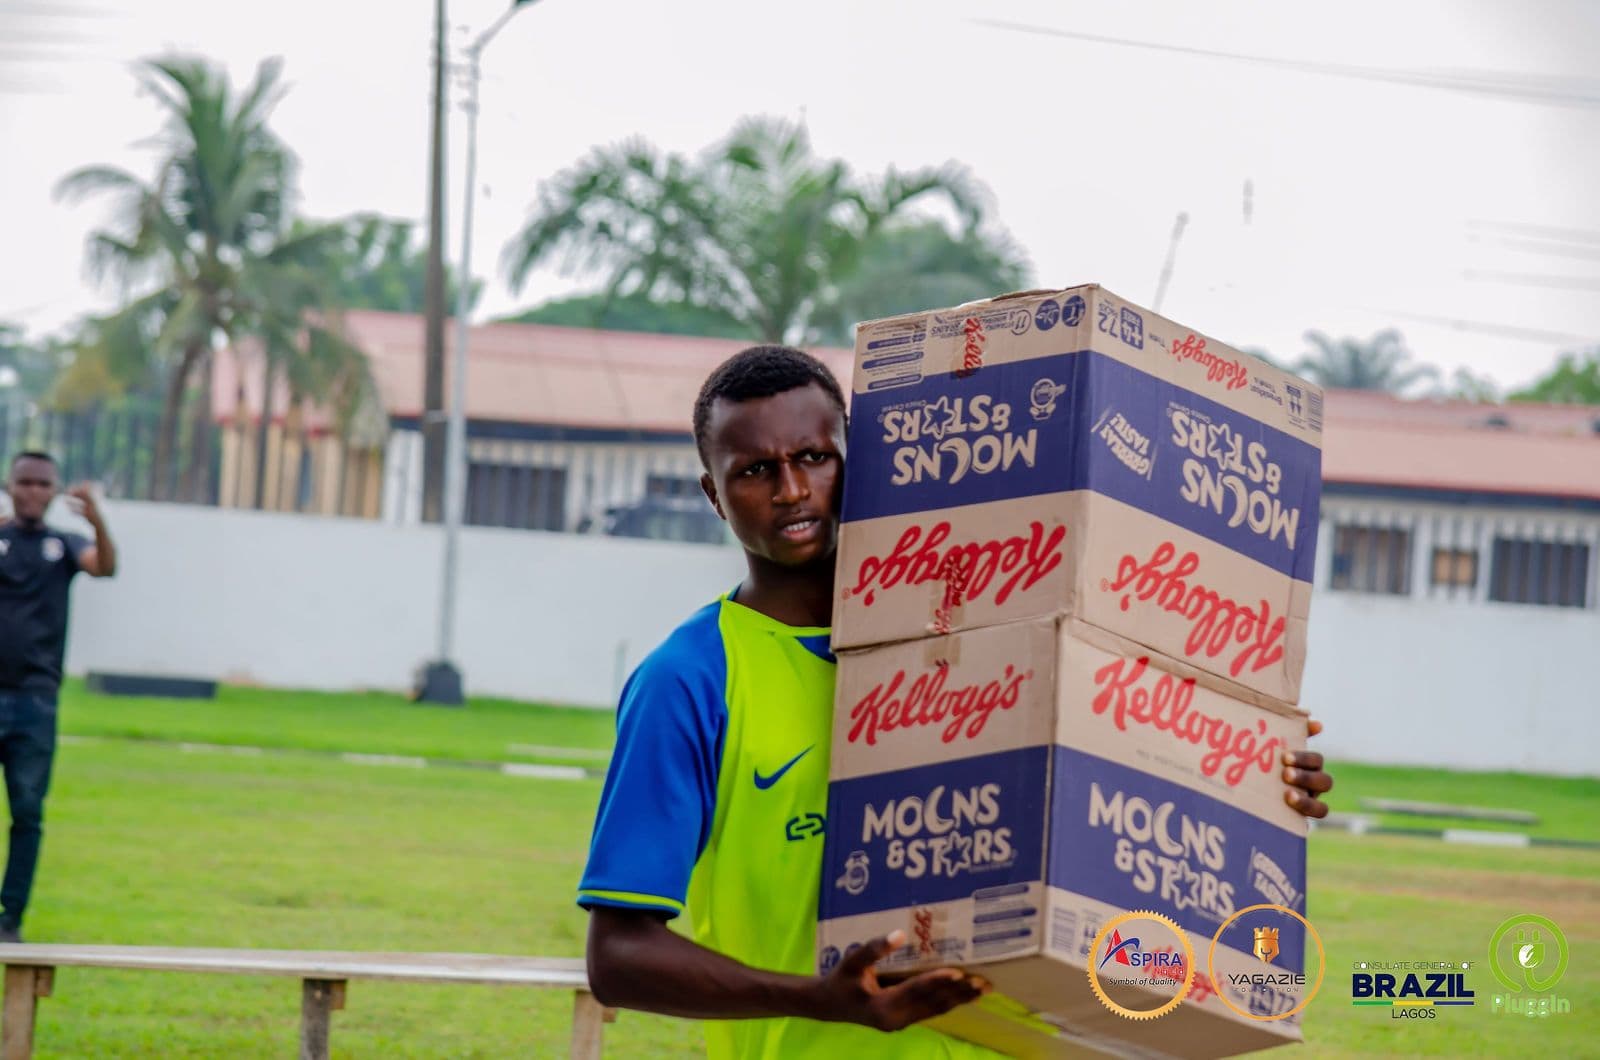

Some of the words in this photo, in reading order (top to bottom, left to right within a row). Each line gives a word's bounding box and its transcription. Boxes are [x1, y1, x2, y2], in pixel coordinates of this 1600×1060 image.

[1098, 312, 1118, 338] 72
[1172, 334, 1248, 390] Kellogg's
[851, 521, 1066, 606] Kellogg's
[1110, 542, 1287, 677] Kellogg's
[847, 664, 1026, 746] Kellogg's
[1092, 656, 1284, 787] Kellogg's
